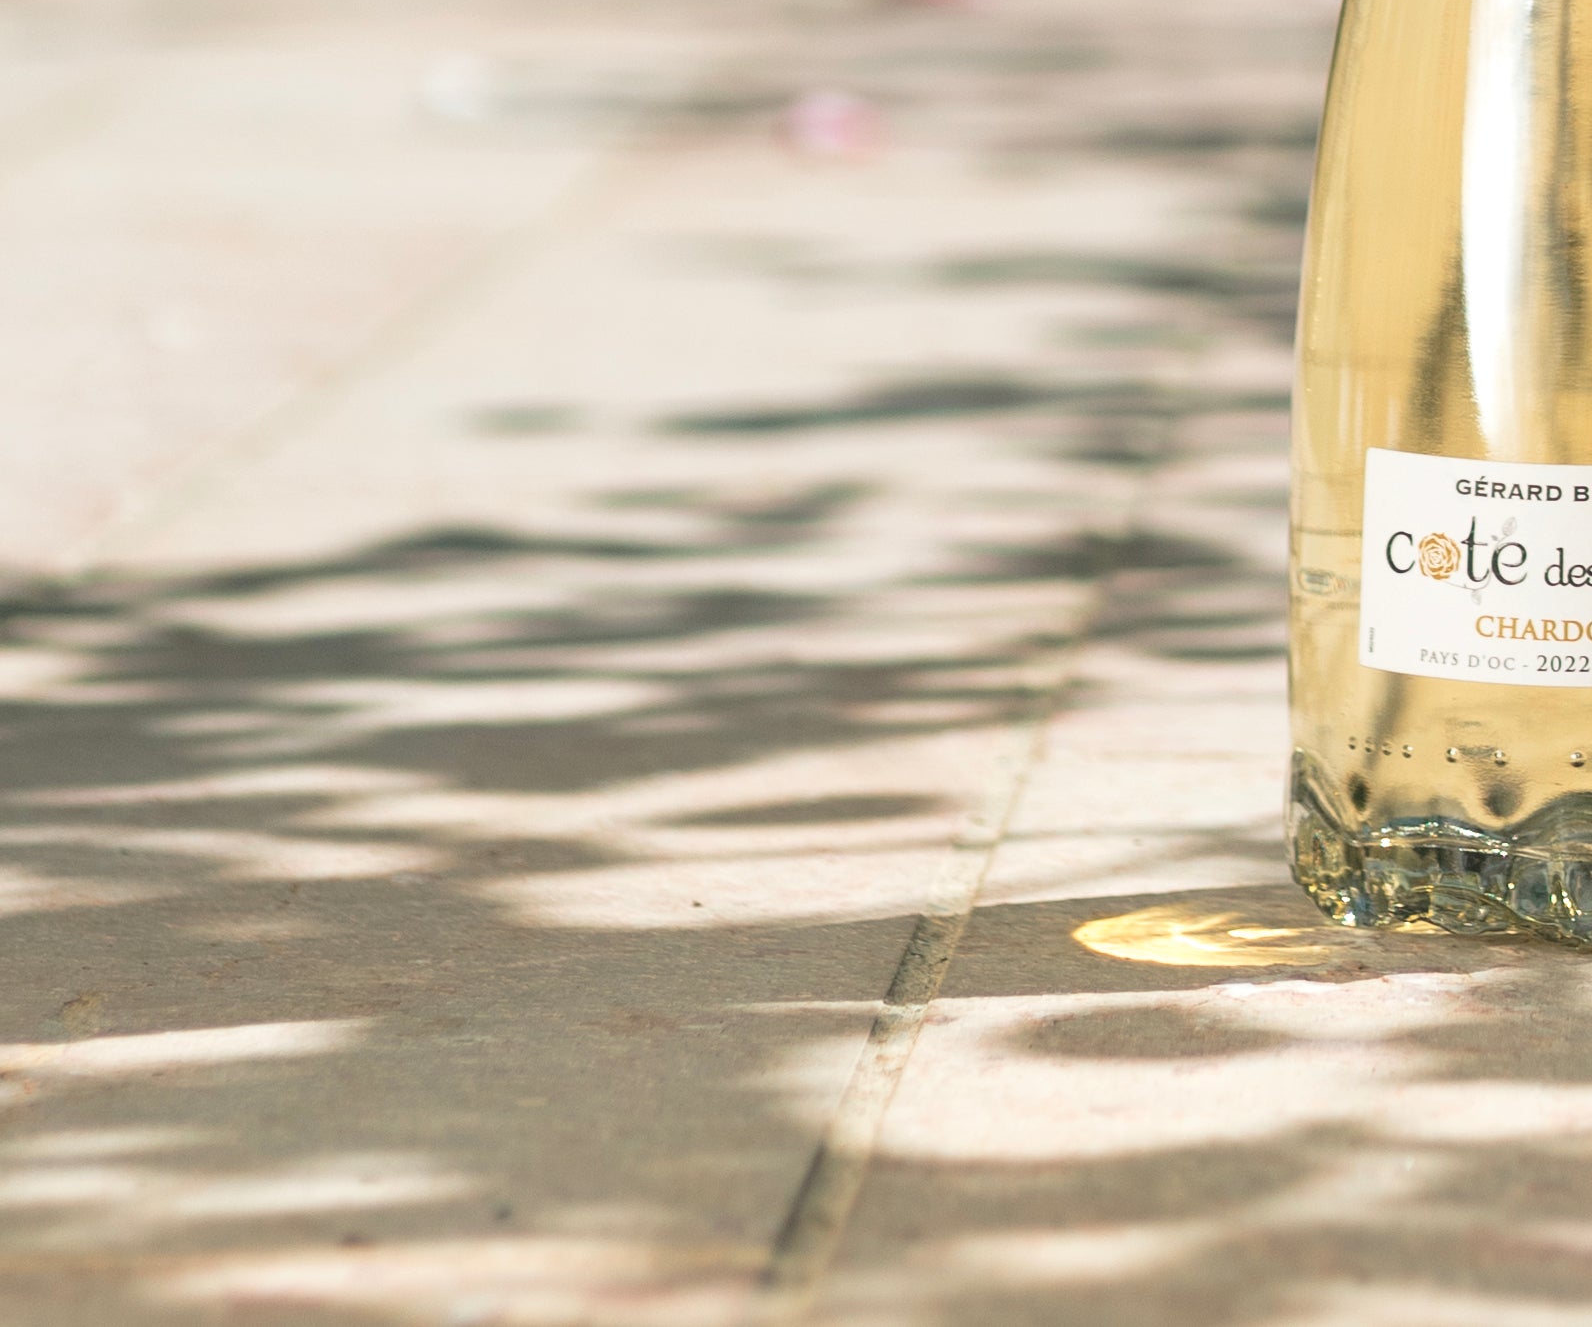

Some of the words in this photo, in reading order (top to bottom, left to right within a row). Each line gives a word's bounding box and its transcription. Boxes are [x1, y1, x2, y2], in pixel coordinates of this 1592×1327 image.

[1456, 476, 1563, 502] GÉRARD
[1420, 648, 1459, 666] PAYS
[1467, 654, 1517, 671] D'OC
[1536, 654, 1591, 673] 2022
